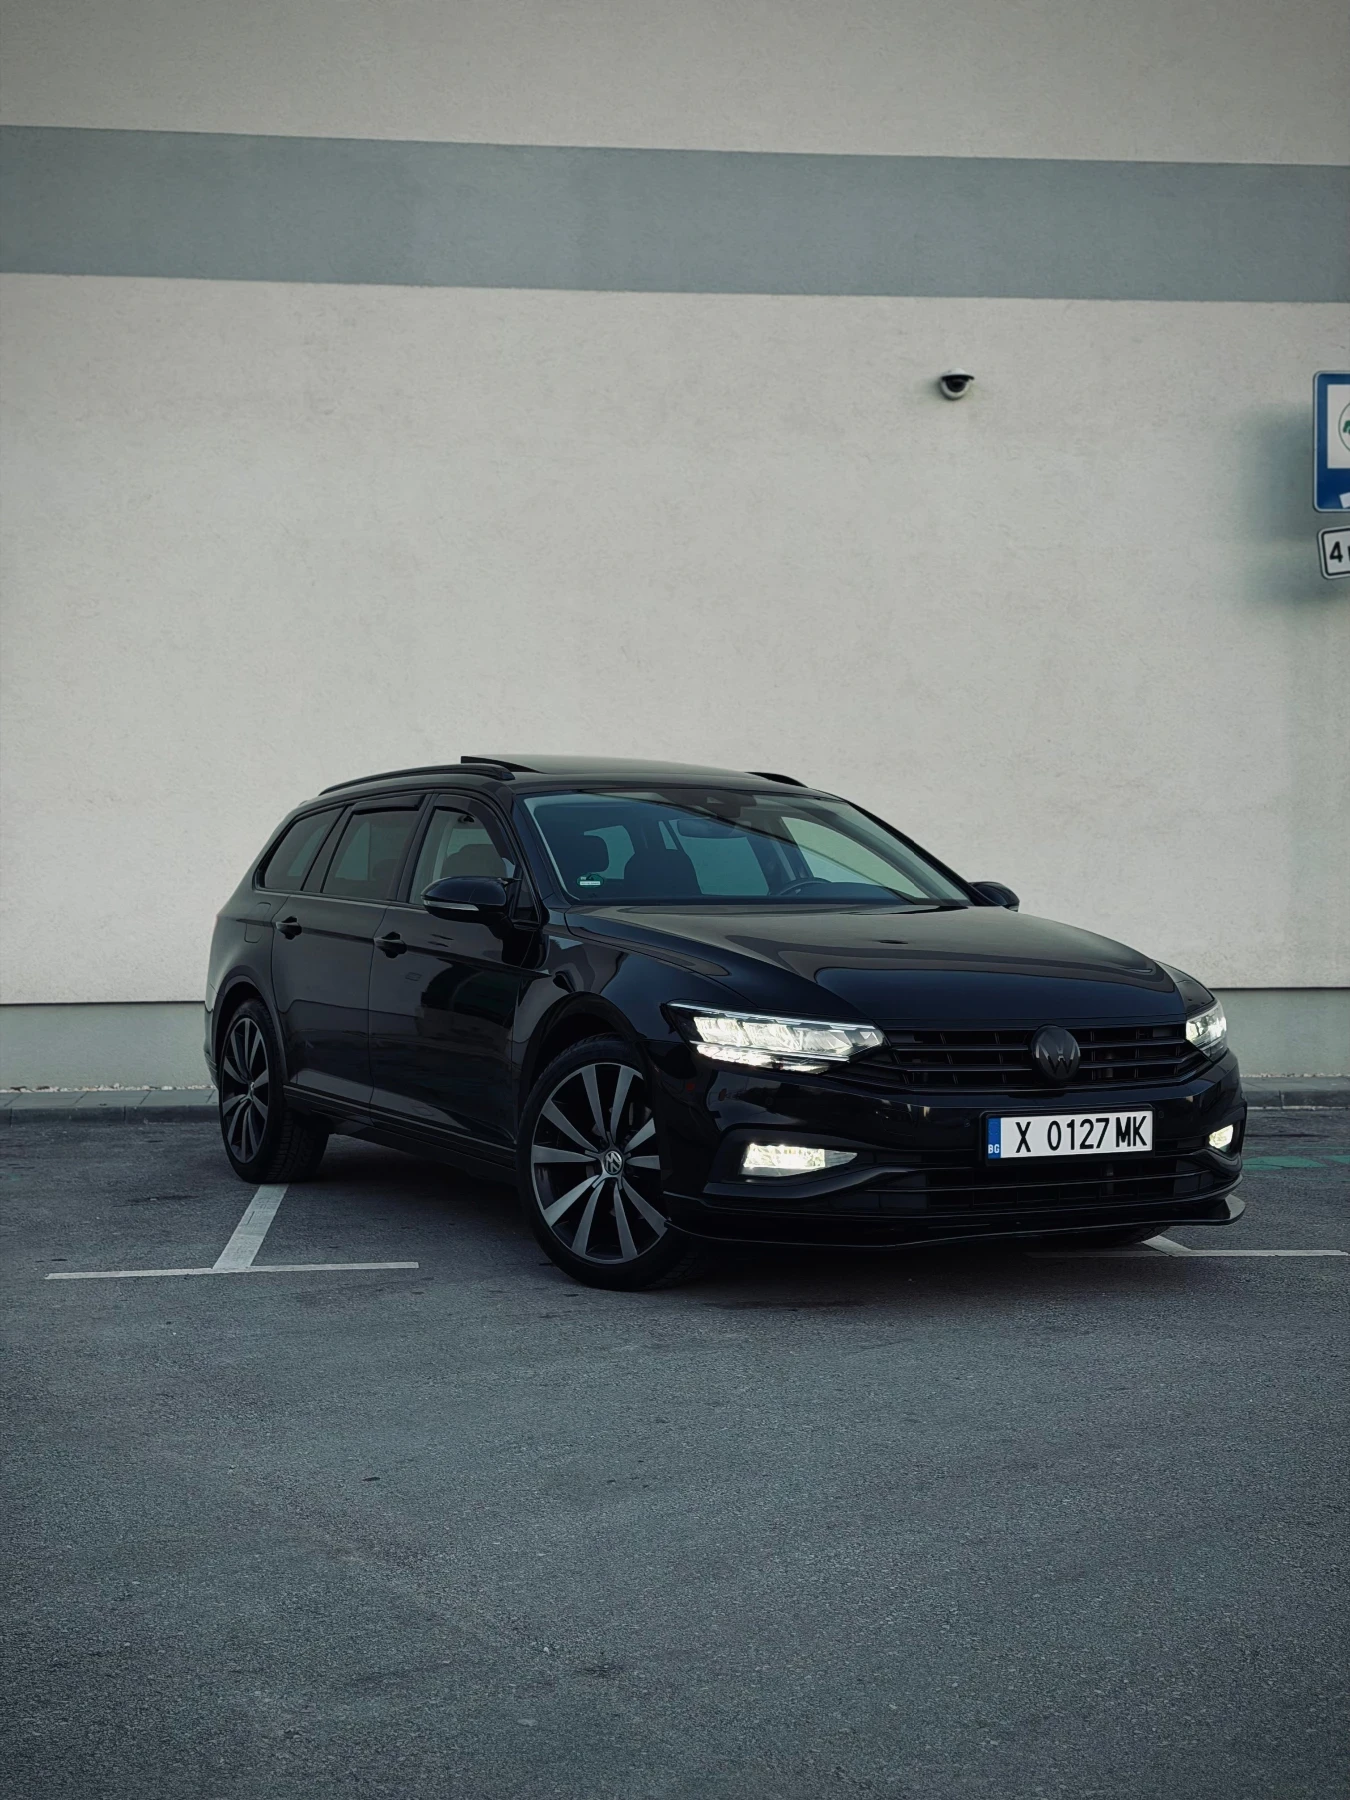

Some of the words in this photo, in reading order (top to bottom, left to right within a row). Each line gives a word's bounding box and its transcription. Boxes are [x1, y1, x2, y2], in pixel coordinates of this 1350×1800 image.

[1329, 541, 1343, 563] 4
[1015, 1121, 1032, 1153] X
[1047, 1118, 1110, 1151] 0127
[1115, 1115, 1148, 1148] MK
[988, 1144, 1000, 1154] BG
